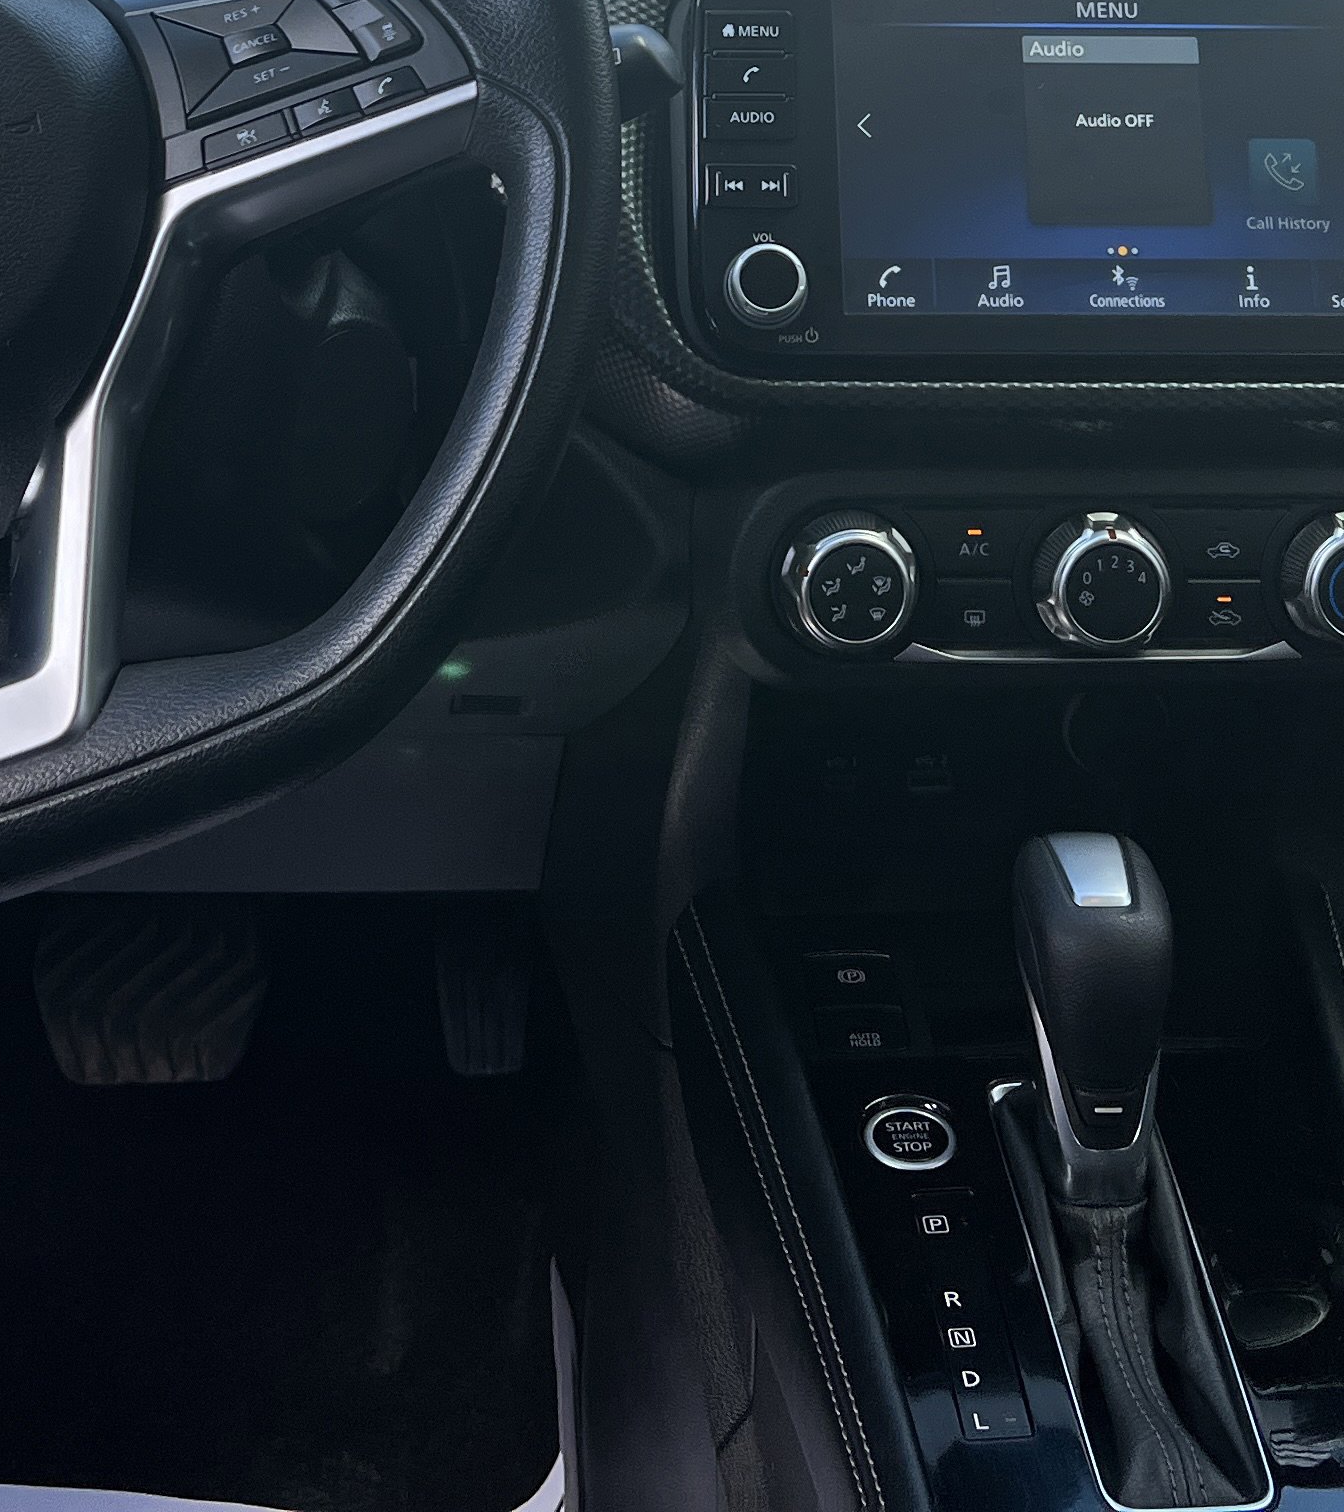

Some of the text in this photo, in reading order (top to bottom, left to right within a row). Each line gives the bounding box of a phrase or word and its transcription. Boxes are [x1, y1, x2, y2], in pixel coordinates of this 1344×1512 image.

[223, 8, 248, 24] RES
[1076, 1, 1138, 19] MENU
[738, 25, 780, 37] MENU
[232, 33, 278, 54] CANCEL
[1029, 40, 1084, 57] Audio
[253, 68, 276, 84] SET
[729, 111, 775, 123] AUDIO
[1075, 113, 1154, 128] Audio OFF
[1246, 216, 1331, 233] Call History
[752, 233, 775, 243] VOL
[867, 294, 916, 308] Phone
[977, 294, 1024, 308] Audio
[1089, 294, 1165, 308] Connections
[1238, 294, 1270, 308] Info
[779, 335, 803, 343] PUSH
[959, 542, 989, 558] A/C
[1082, 555, 1147, 586] 0 1 2 3 4
[849, 1032, 880, 1040] AUTO
[885, 1121, 931, 1132] START
[892, 1141, 933, 1153] STOP
[929, 1218, 942, 1231] P
[943, 1291, 962, 1308] R
[954, 1331, 970, 1345] N
[962, 1370, 981, 1388] D
[973, 1413, 990, 1430] L
